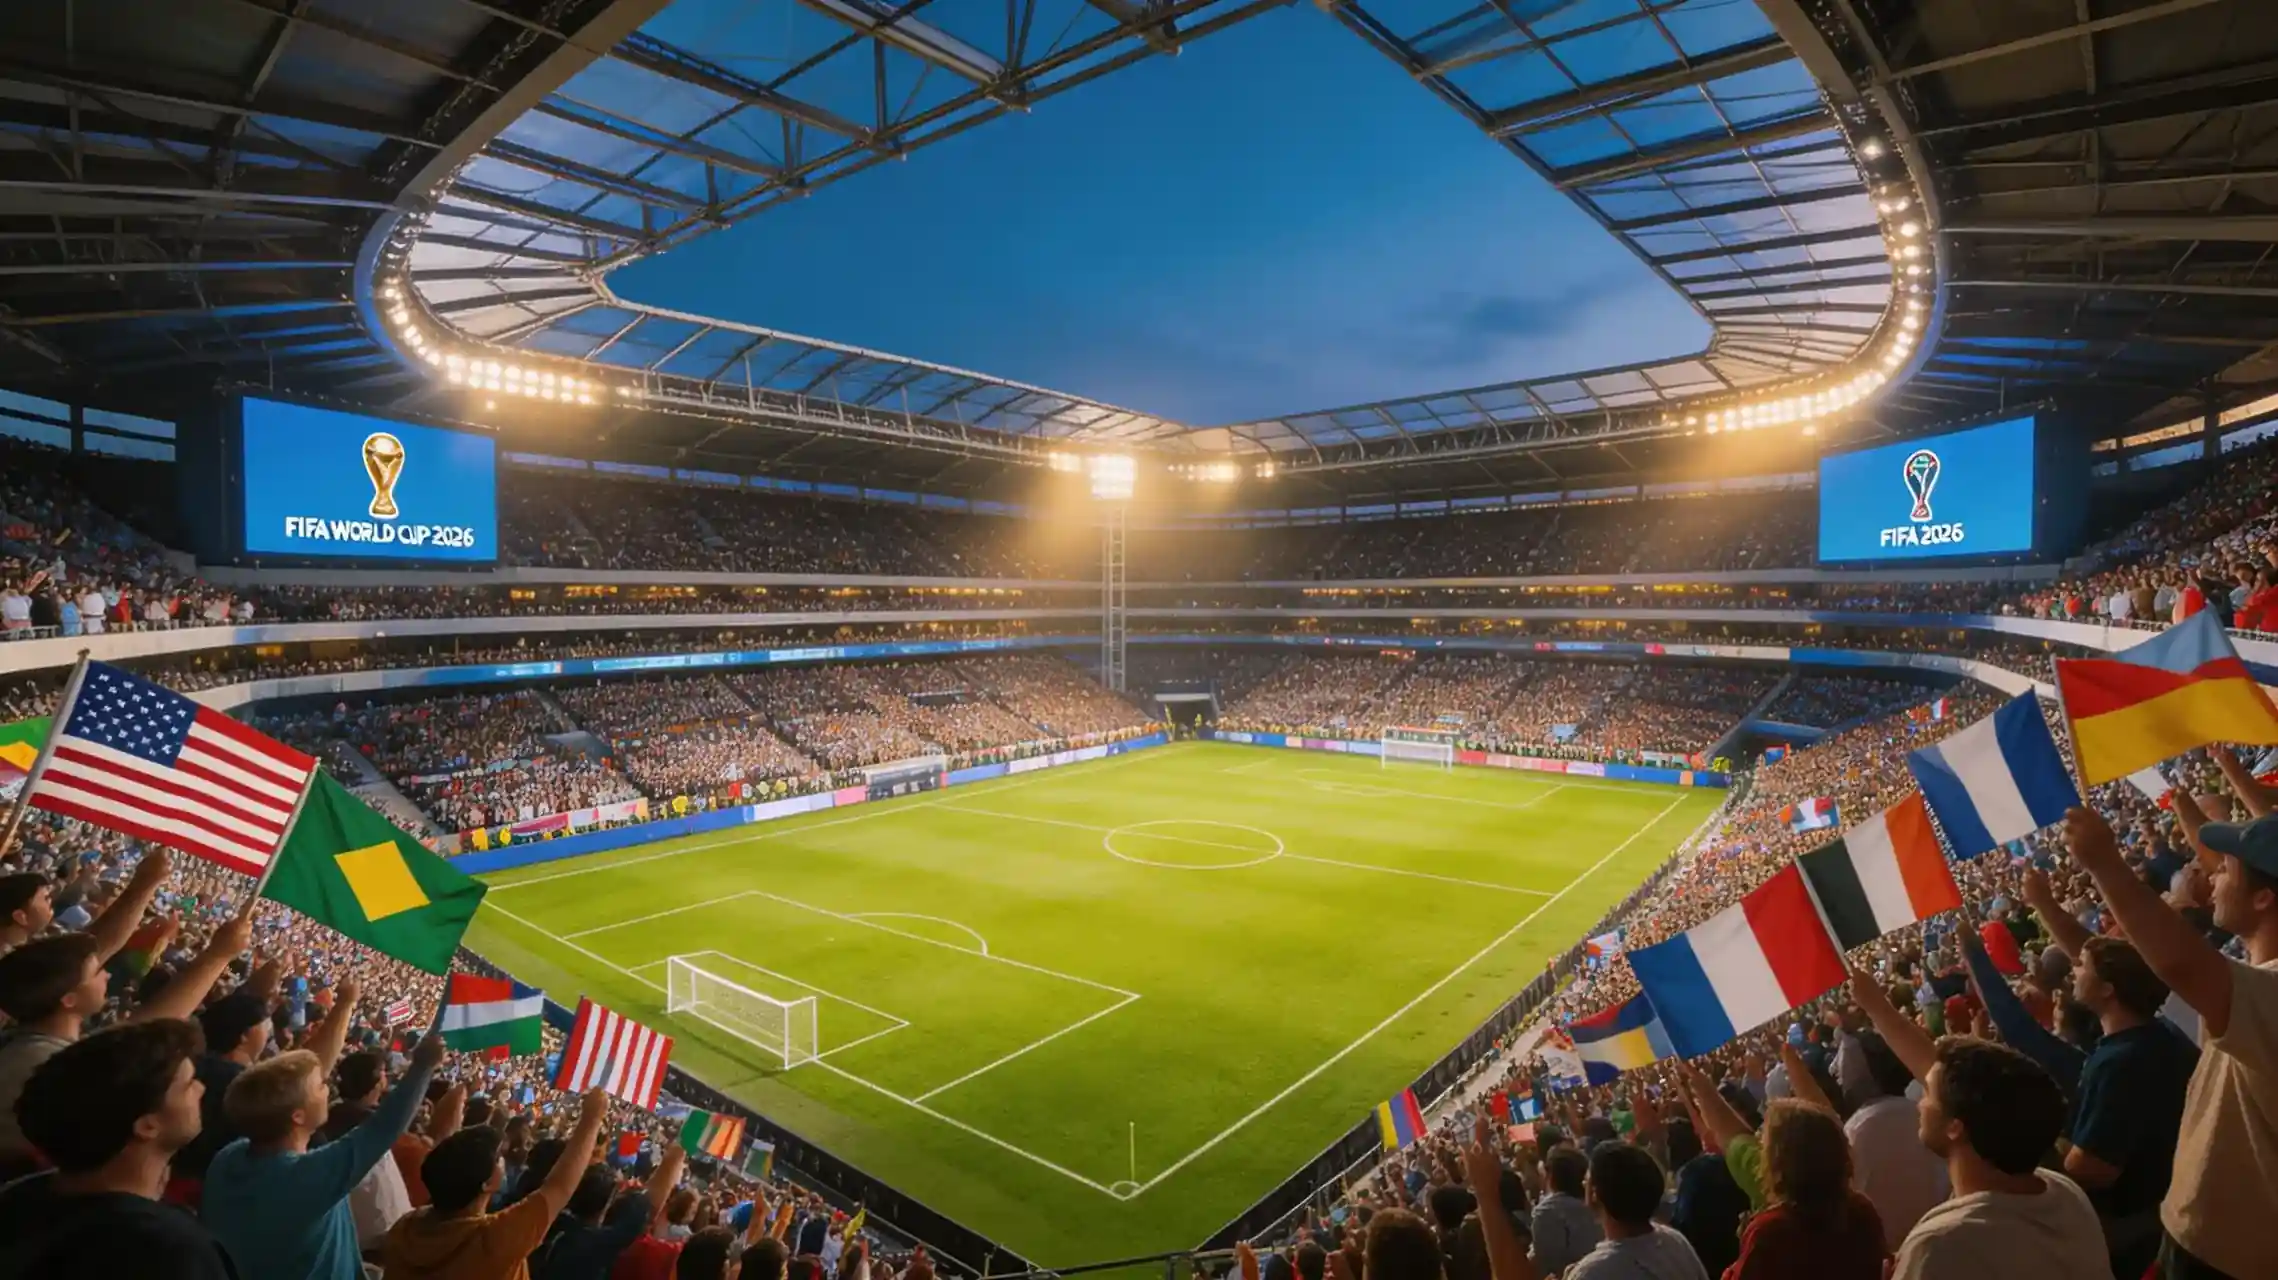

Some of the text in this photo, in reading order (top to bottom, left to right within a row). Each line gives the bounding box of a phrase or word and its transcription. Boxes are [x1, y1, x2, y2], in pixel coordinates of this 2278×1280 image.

[285, 517, 475, 547] FIFA WORLD CUP 2026
[1880, 522, 1965, 547] FIFA 2026
